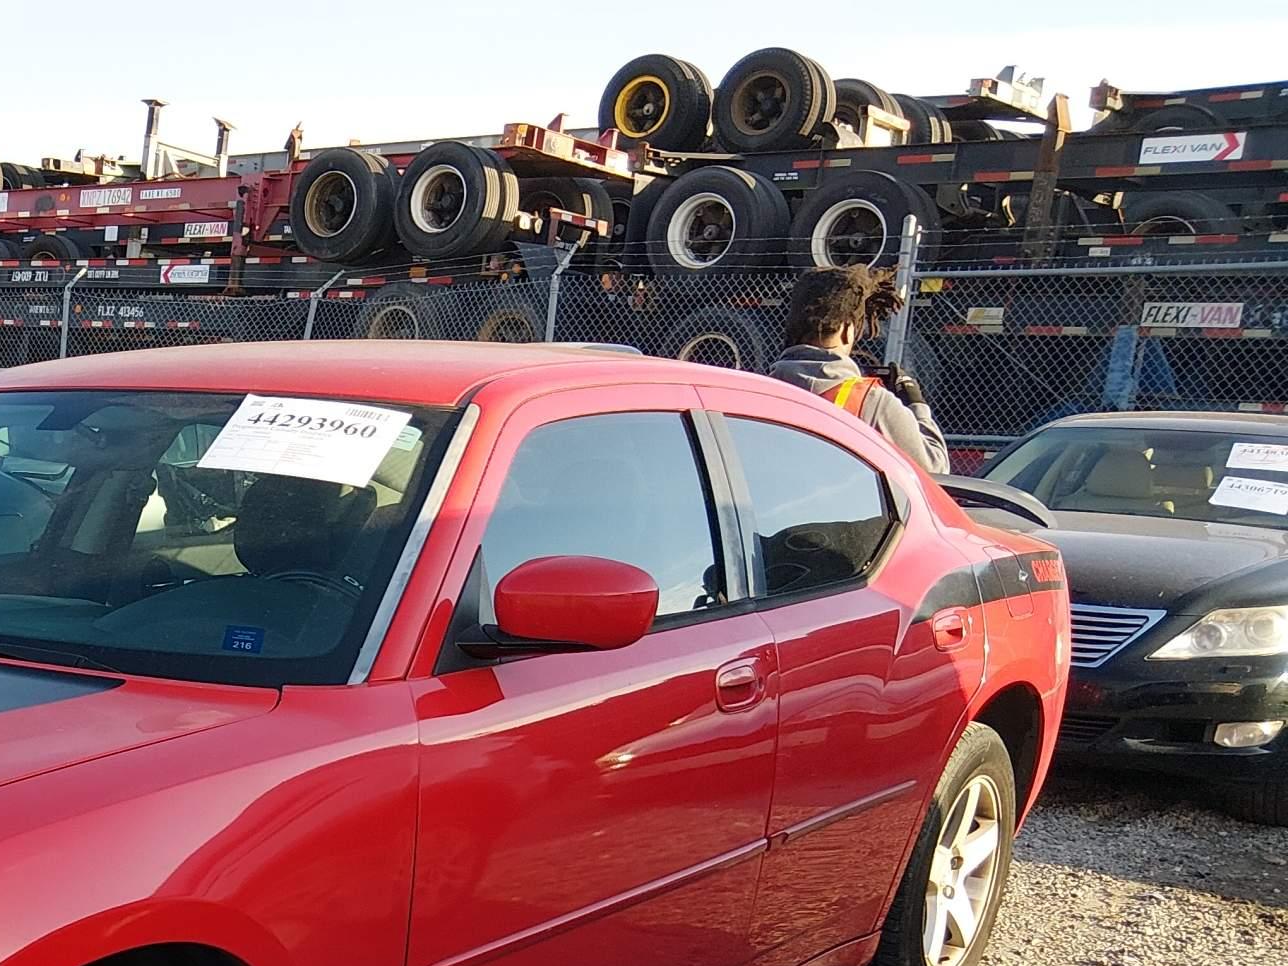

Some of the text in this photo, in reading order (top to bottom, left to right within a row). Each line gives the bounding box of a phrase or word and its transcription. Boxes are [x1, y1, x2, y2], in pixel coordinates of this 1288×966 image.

[1143, 143, 1223, 155] FLEXI VAN
[185, 223, 227, 236] FLEXI-VAN
[98, 305, 115, 317] FLXZ
[1143, 306, 1241, 324] FLEXI-VAN
[247, 412, 377, 439] 44293960
[232, 640, 253, 650] 216
